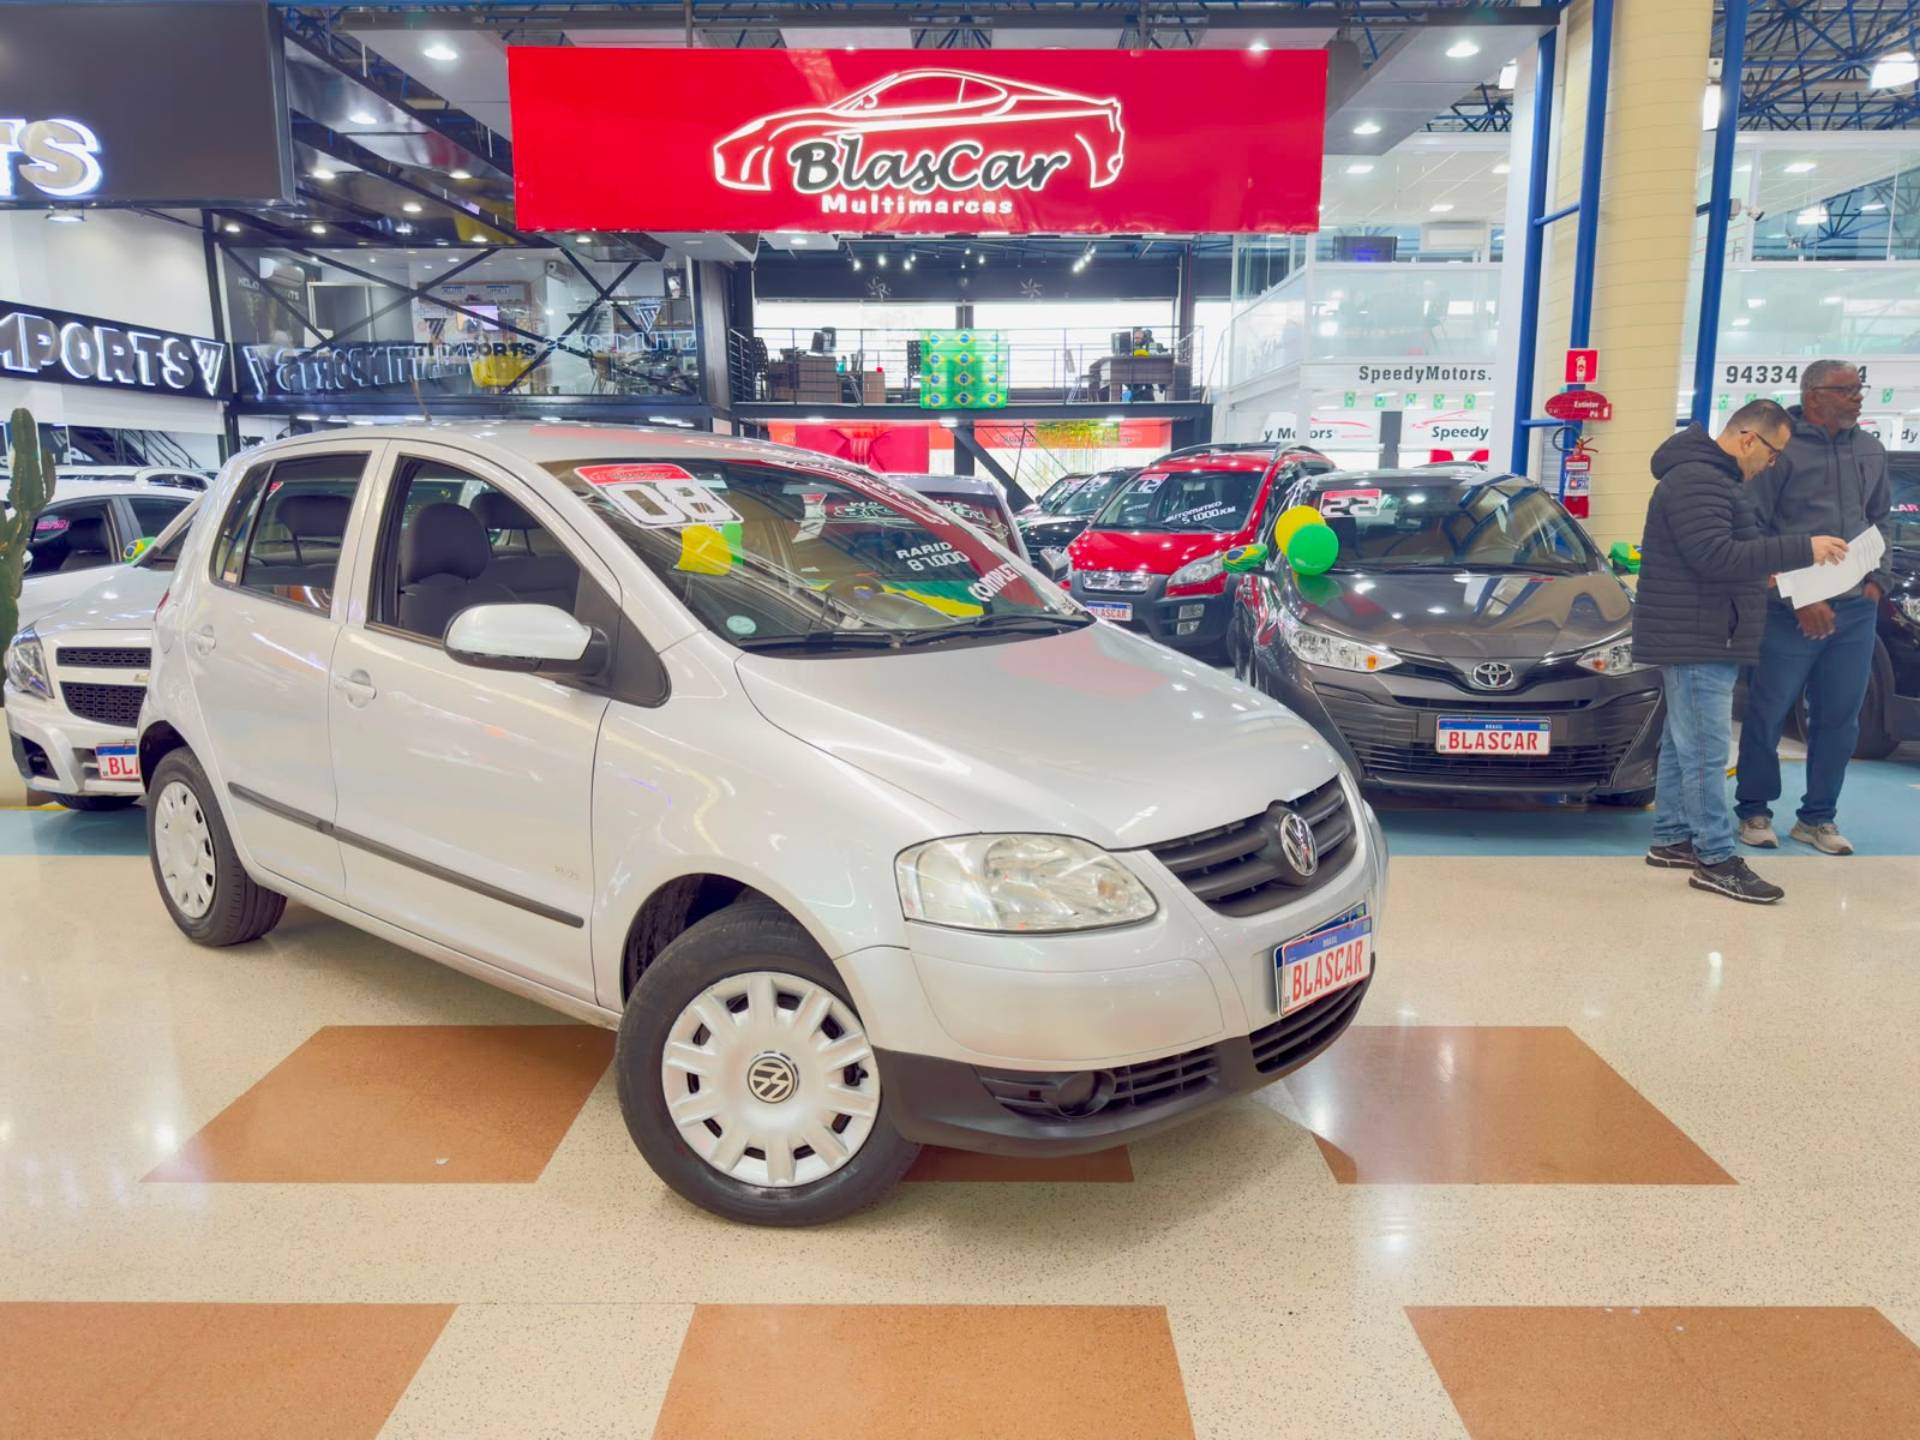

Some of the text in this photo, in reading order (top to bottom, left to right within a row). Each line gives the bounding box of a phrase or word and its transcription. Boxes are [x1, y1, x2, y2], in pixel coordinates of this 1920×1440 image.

[788, 135, 1071, 194] BlasCar
[821, 194, 1013, 215] Multimarcas
[1359, 365, 1492, 383] SpeedyMotors.
[1431, 425, 1489, 440] Speedy
[605, 480, 734, 524] 08
[1322, 496, 1378, 516] 22
[1448, 731, 1538, 750] BLASCAR
[108, 756, 139, 775] BL
[1292, 939, 1363, 1002] BLASCAR
